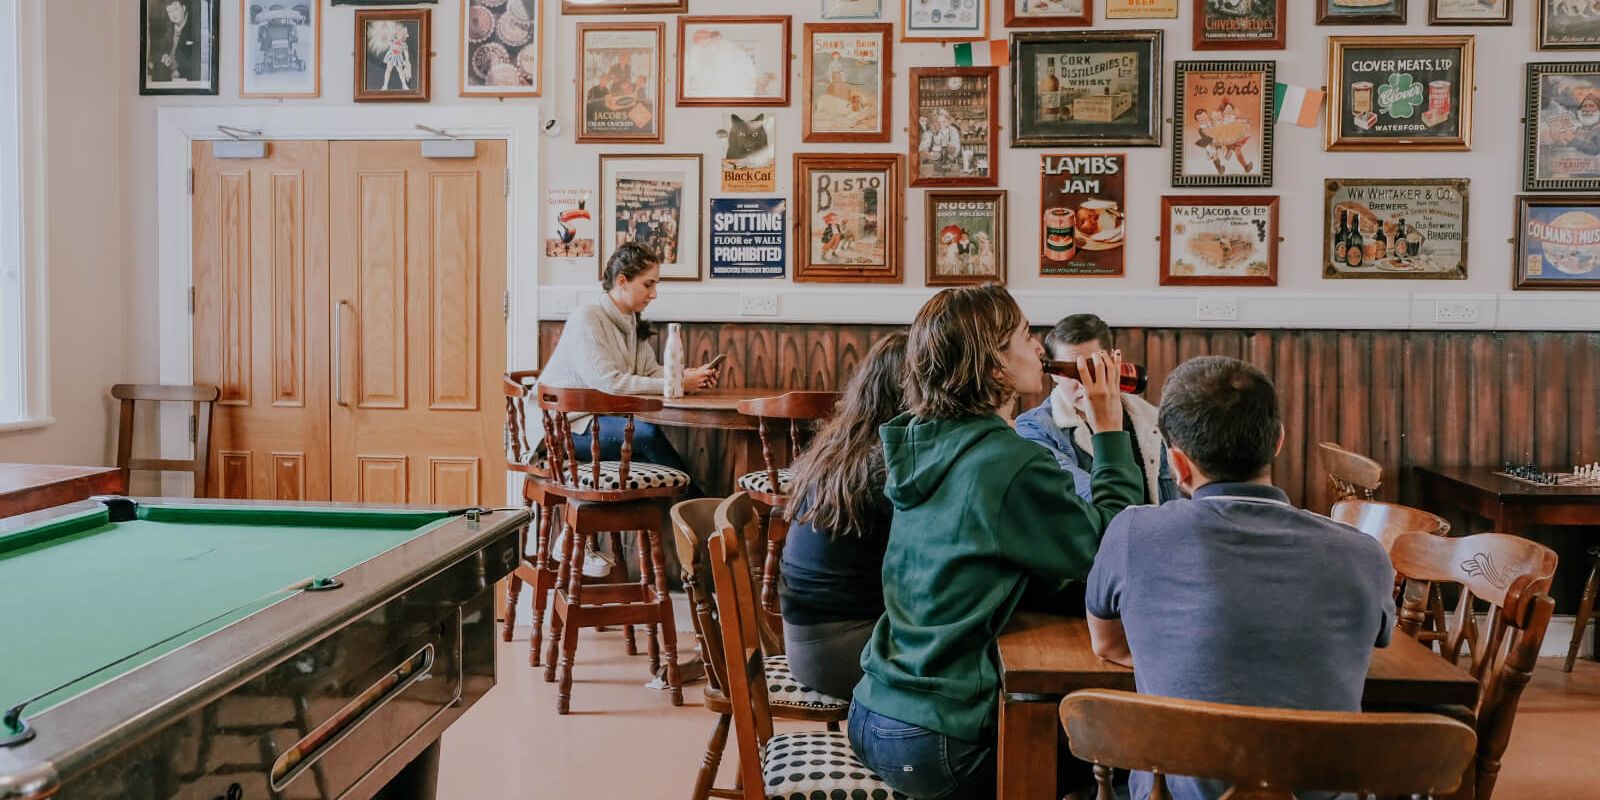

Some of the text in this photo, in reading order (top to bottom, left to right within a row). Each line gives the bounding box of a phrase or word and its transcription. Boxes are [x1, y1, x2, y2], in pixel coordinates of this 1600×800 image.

[1060, 55, 1091, 66] CORK
[1352, 59, 1453, 72] CLOVER MEATS, LTD
[1061, 59, 1119, 79] DISTILLERIES
[724, 171, 771, 182] Black Cat
[1060, 180, 1100, 194] JAM
[817, 174, 880, 213] BISTO
[1368, 188, 1421, 200] WHITAKER
[1425, 189, 1432, 199] &
[937, 202, 993, 210] NUGGET
[1174, 208, 1183, 216] W
[1191, 207, 1199, 216] R
[1199, 207, 1232, 219] JACOB
[714, 212, 783, 232] SPITTING
[714, 236, 742, 245] FLOOR
[754, 236, 783, 245] WALLS
[714, 246, 783, 262] PROHIBITED
